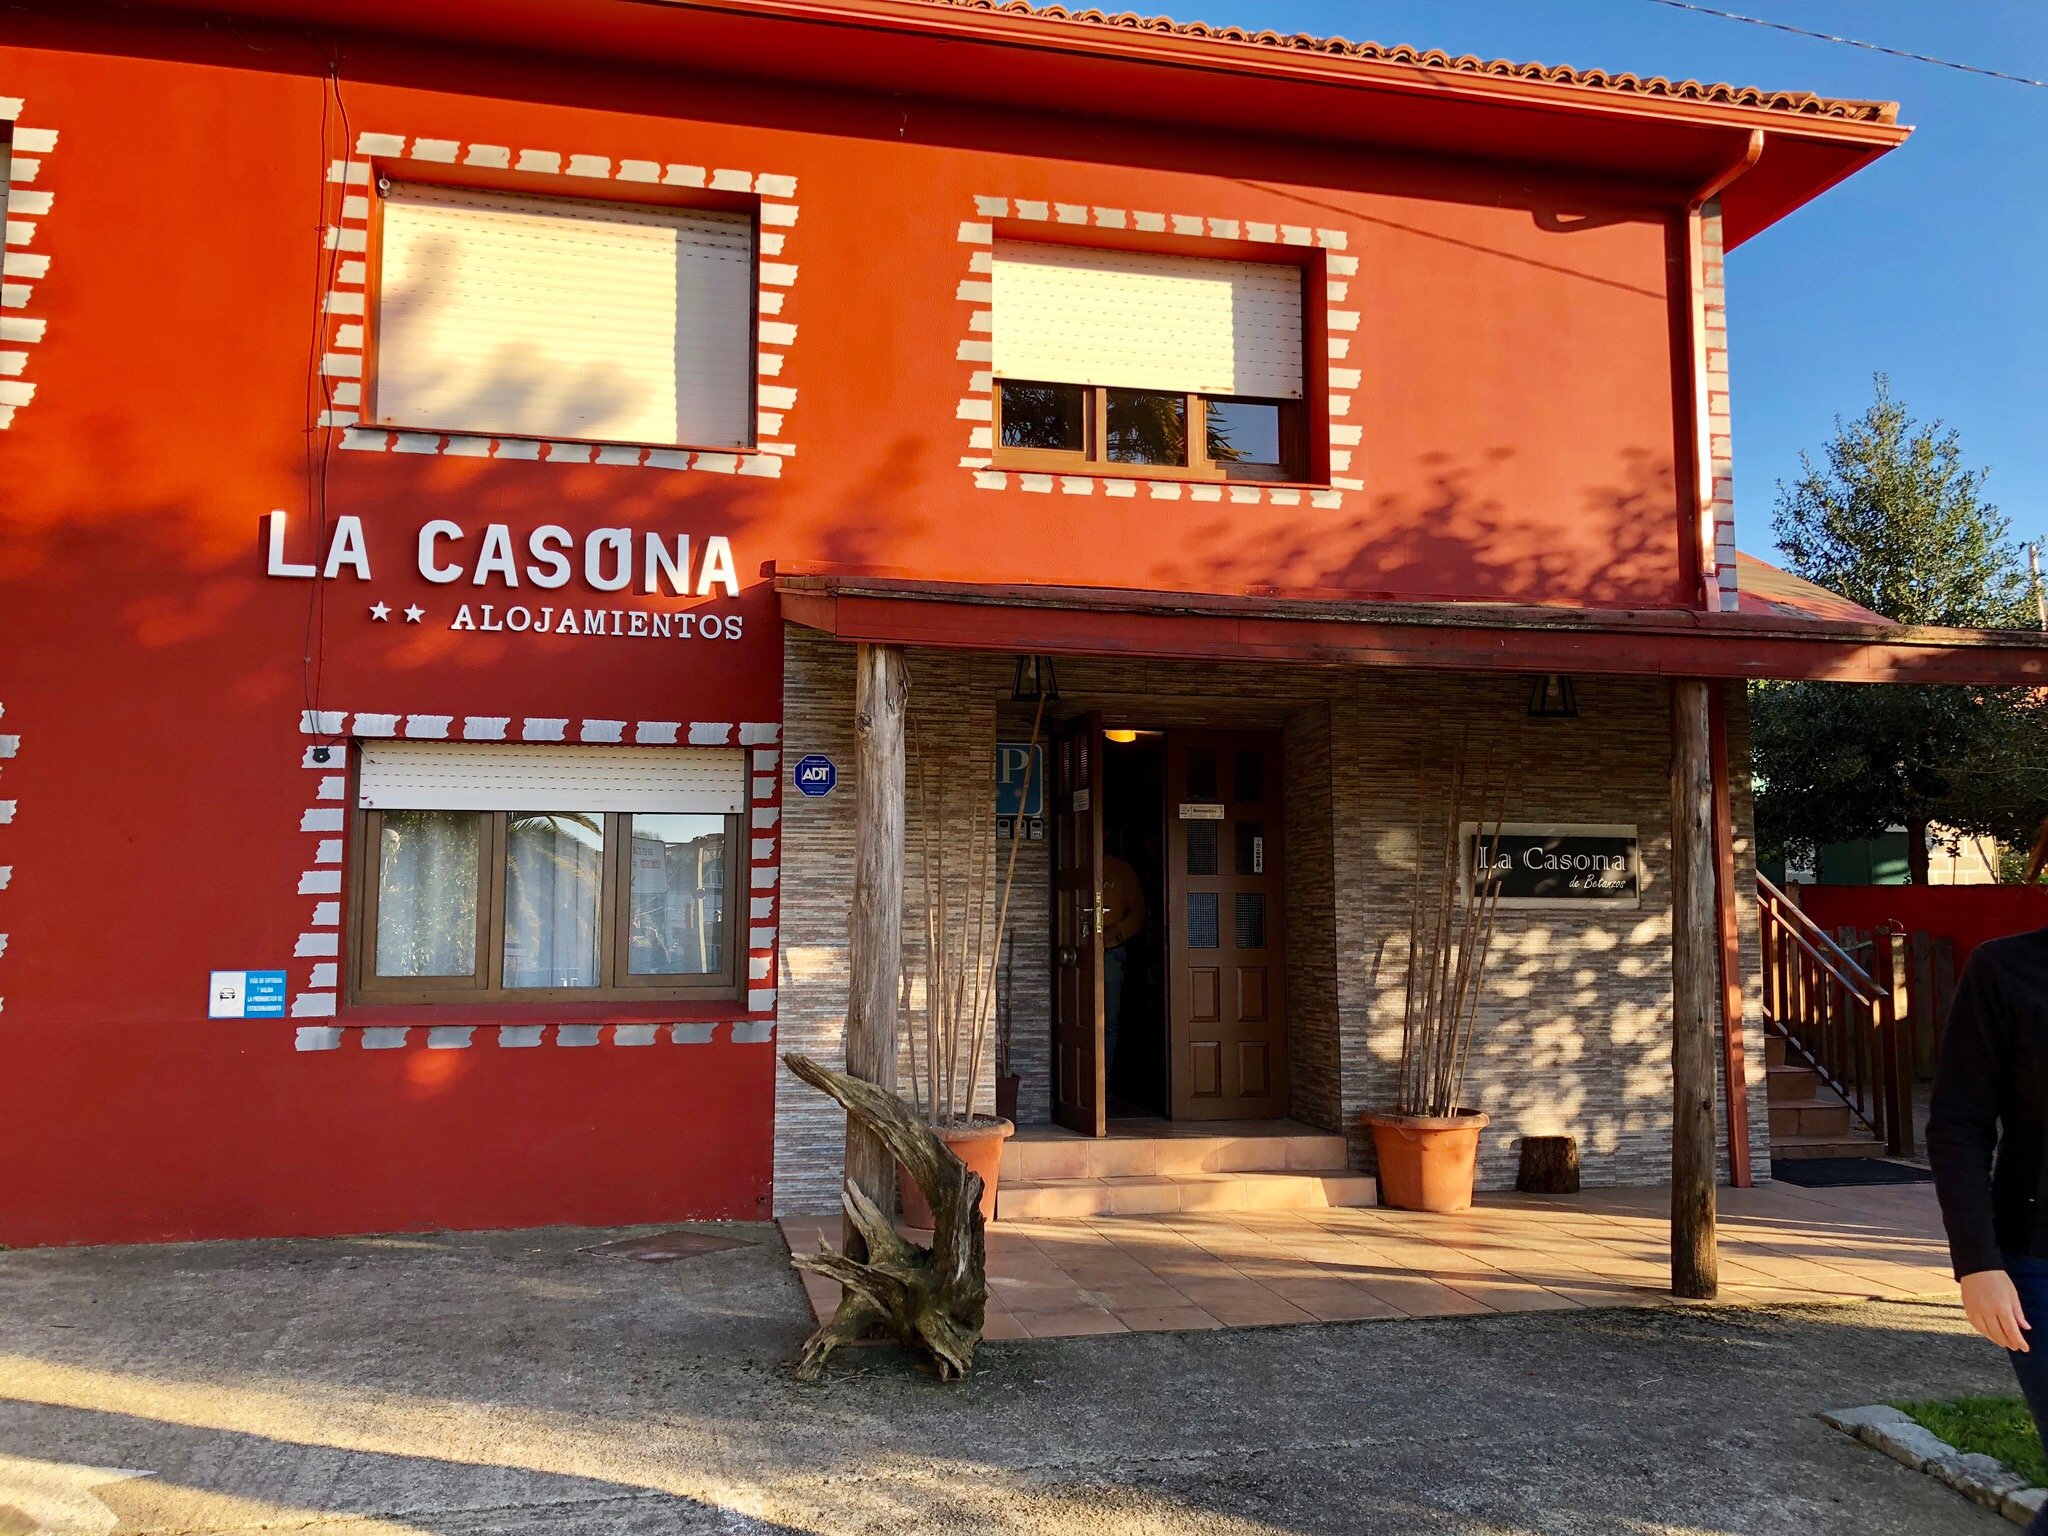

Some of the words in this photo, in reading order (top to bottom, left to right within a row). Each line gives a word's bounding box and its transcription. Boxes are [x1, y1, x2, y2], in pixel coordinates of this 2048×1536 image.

[267, 509, 372, 581] LA
[417, 519, 741, 597] CASONA
[450, 603, 744, 641] ALOJAMIENTOS
[802, 767, 829, 781] ADT
[998, 748, 1030, 784] P
[1478, 846, 1513, 870] La
[1522, 846, 1627, 871] Casona
[1568, 875, 1580, 888] de
[1583, 873, 1627, 889] Betanzos
